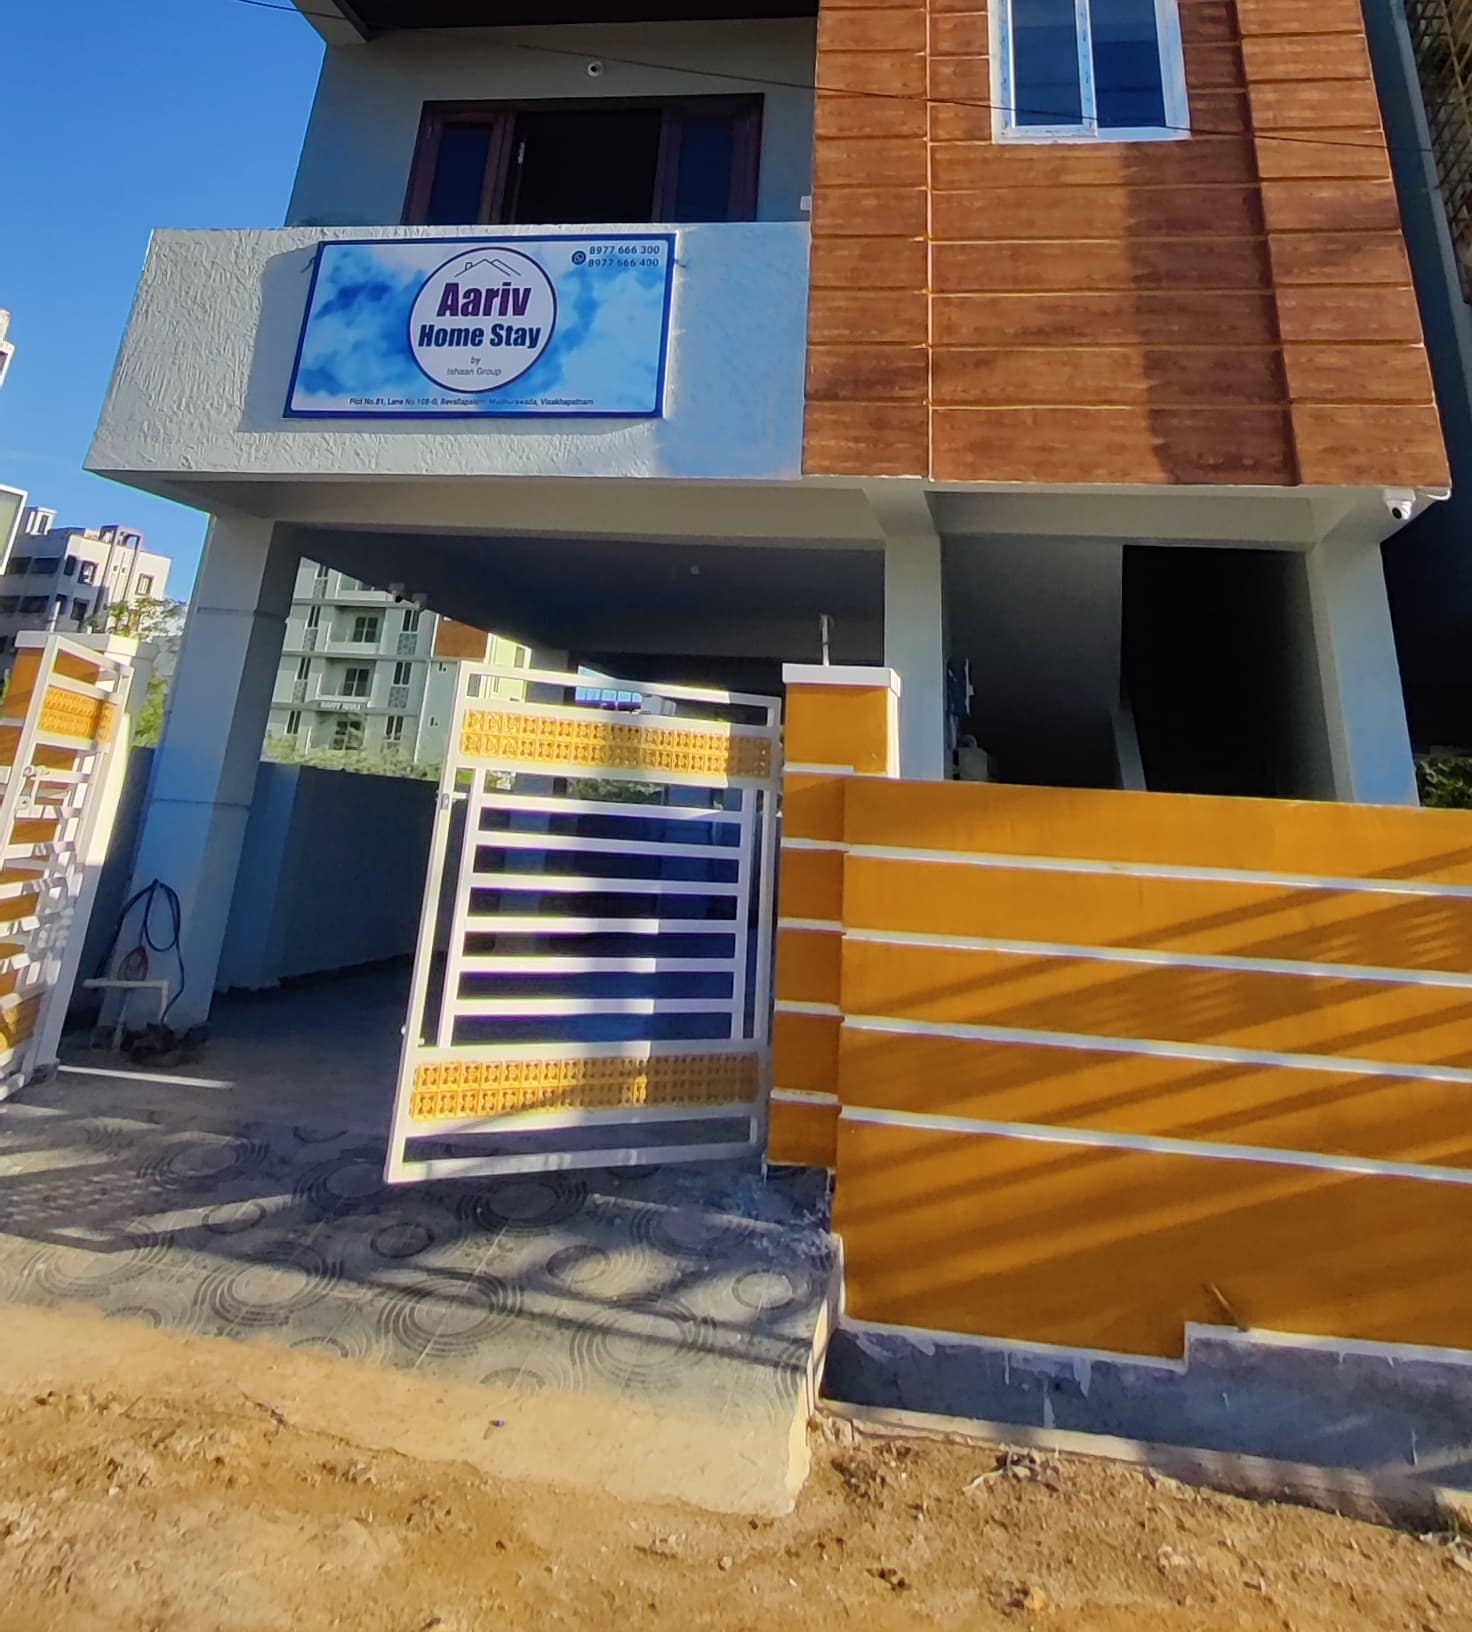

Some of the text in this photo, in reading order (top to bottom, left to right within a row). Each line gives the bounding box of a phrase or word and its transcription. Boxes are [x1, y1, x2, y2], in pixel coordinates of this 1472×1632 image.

[589, 245, 660, 255] 8977 666 300
[588, 258, 659, 267] 8977 666 400
[436, 281, 532, 318] Aariv
[418, 323, 542, 350] Home Stay
[470, 356, 481, 366] by
[447, 367, 502, 377] Ishaan Group
[387, 397, 404, 406] Lane
